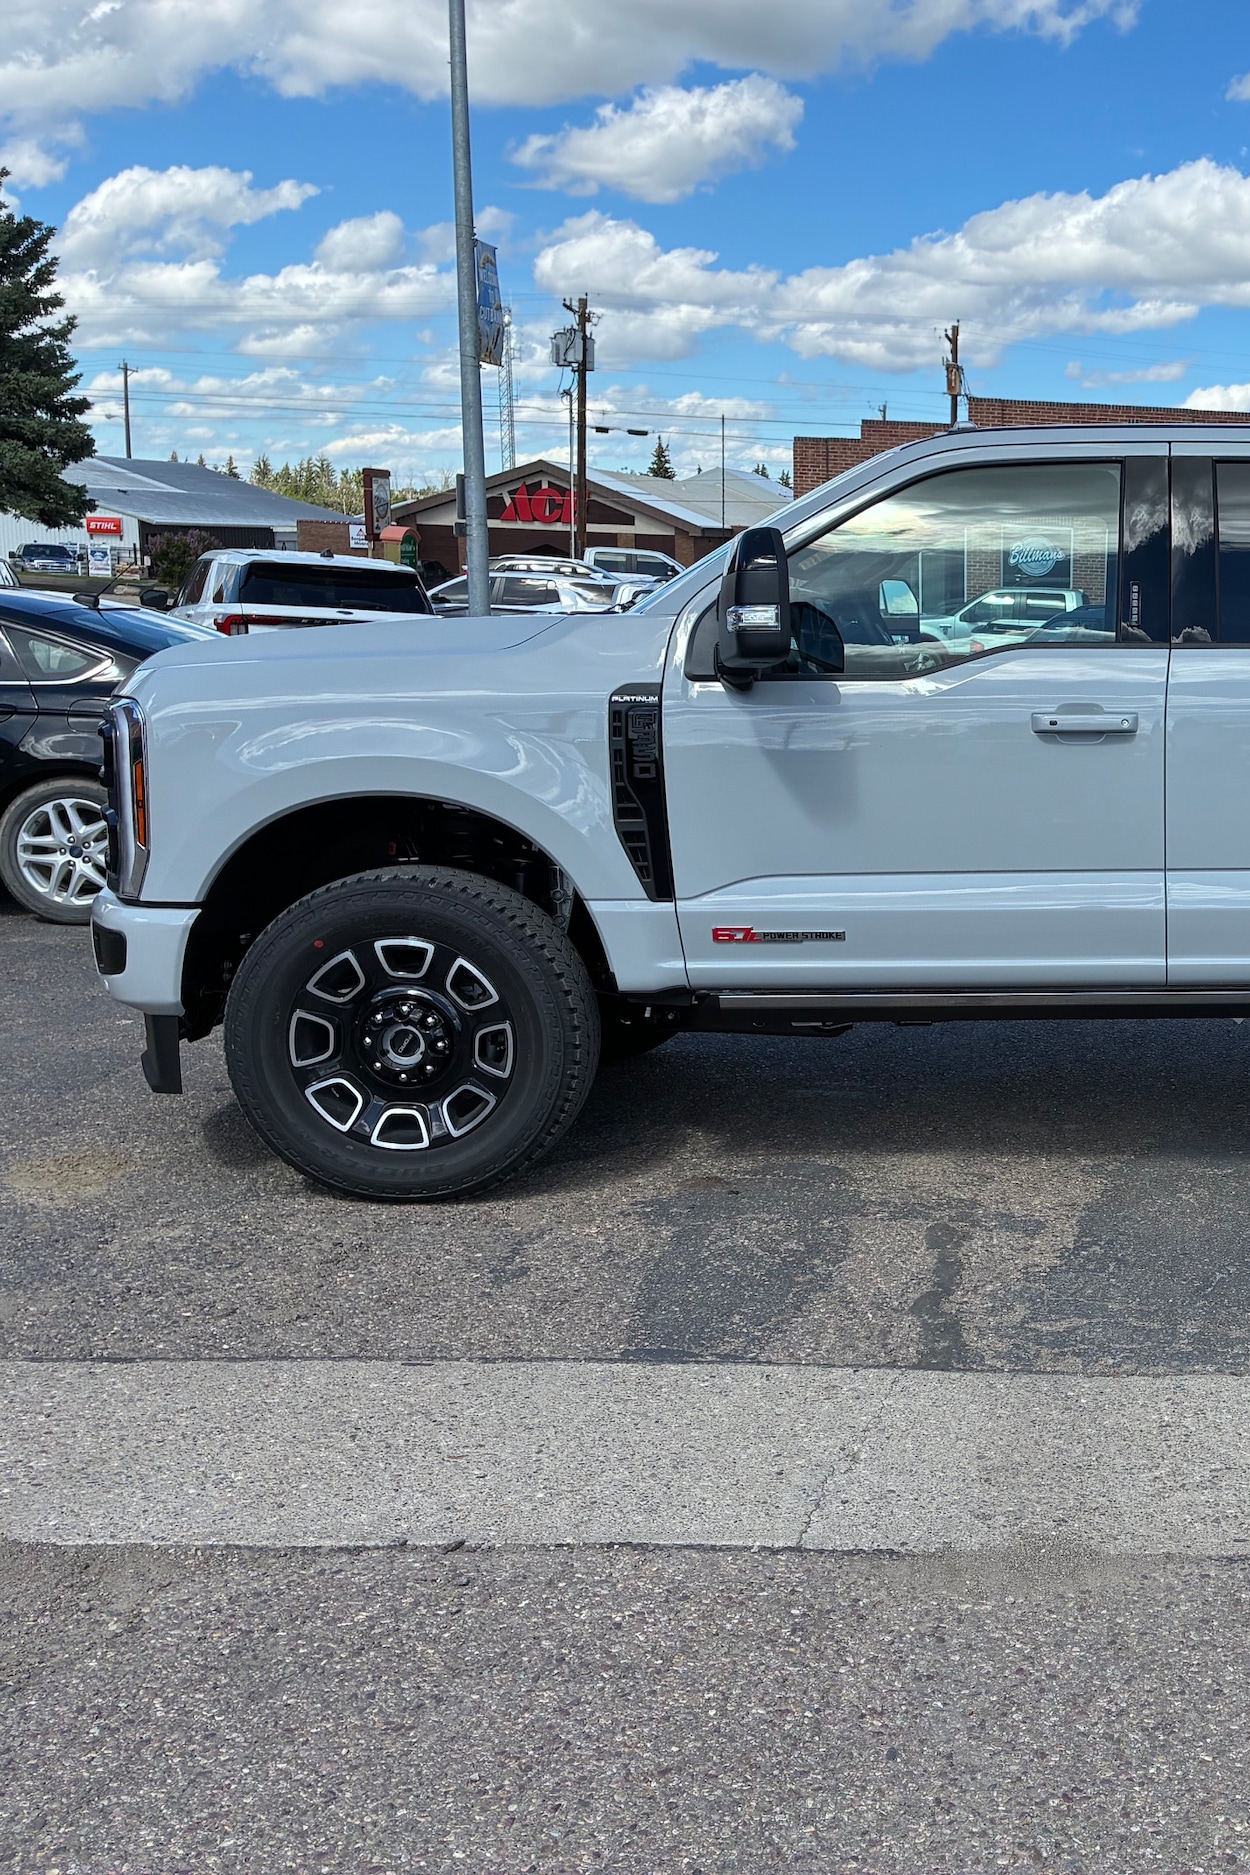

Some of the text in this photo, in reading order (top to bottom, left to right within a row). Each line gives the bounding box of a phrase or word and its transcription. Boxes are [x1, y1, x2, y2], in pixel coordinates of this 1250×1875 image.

[89, 521, 117, 530] STIHL
[763, 931, 799, 940] POWER
[801, 931, 842, 940] STROKE
